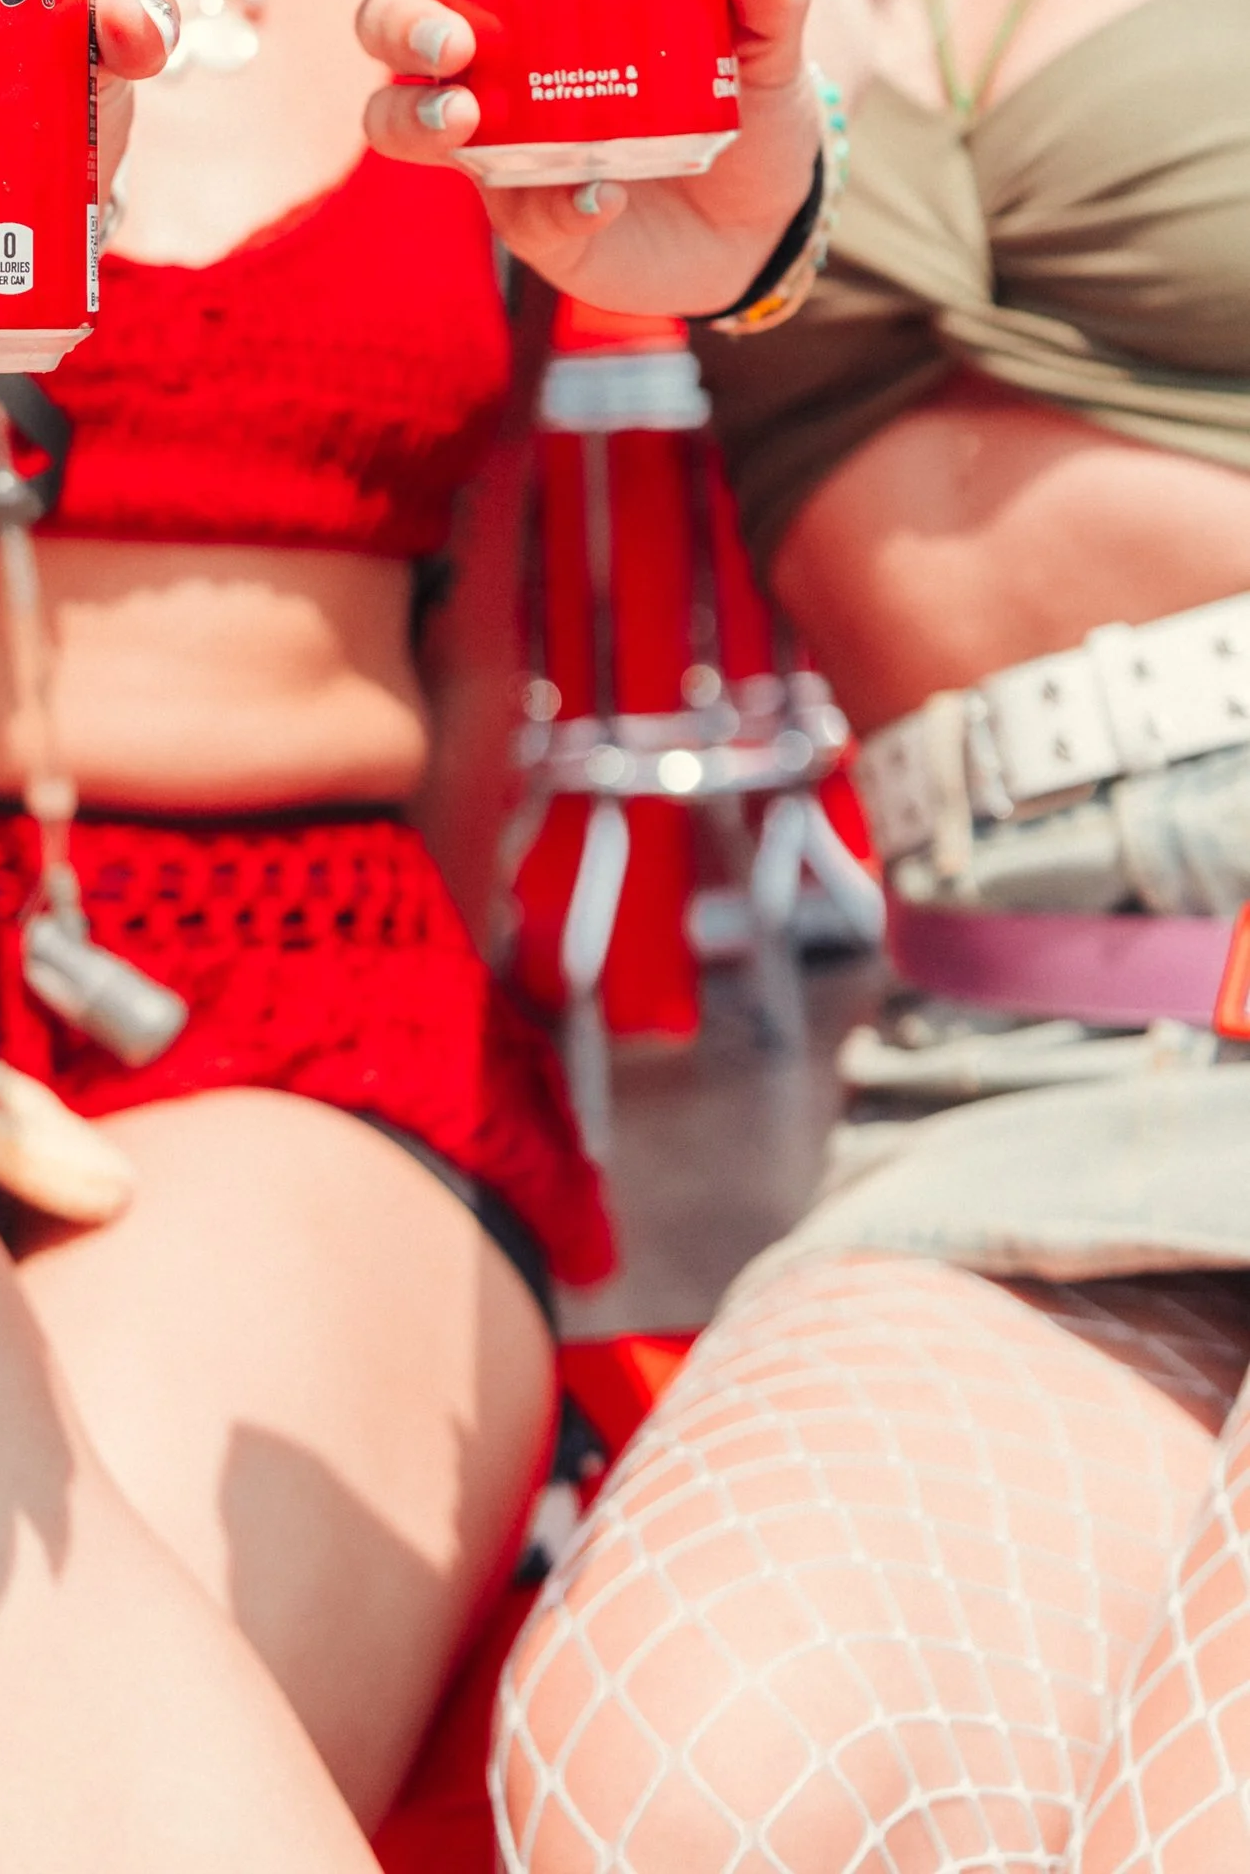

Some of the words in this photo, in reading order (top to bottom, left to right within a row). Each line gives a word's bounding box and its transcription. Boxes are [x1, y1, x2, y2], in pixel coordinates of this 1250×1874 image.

[528, 68, 621, 87] Delicious
[624, 64, 639, 80] &
[531, 82, 639, 102] Refreshing
[3, 231, 17, 260] 0
[10, 275, 26, 286] CAN
